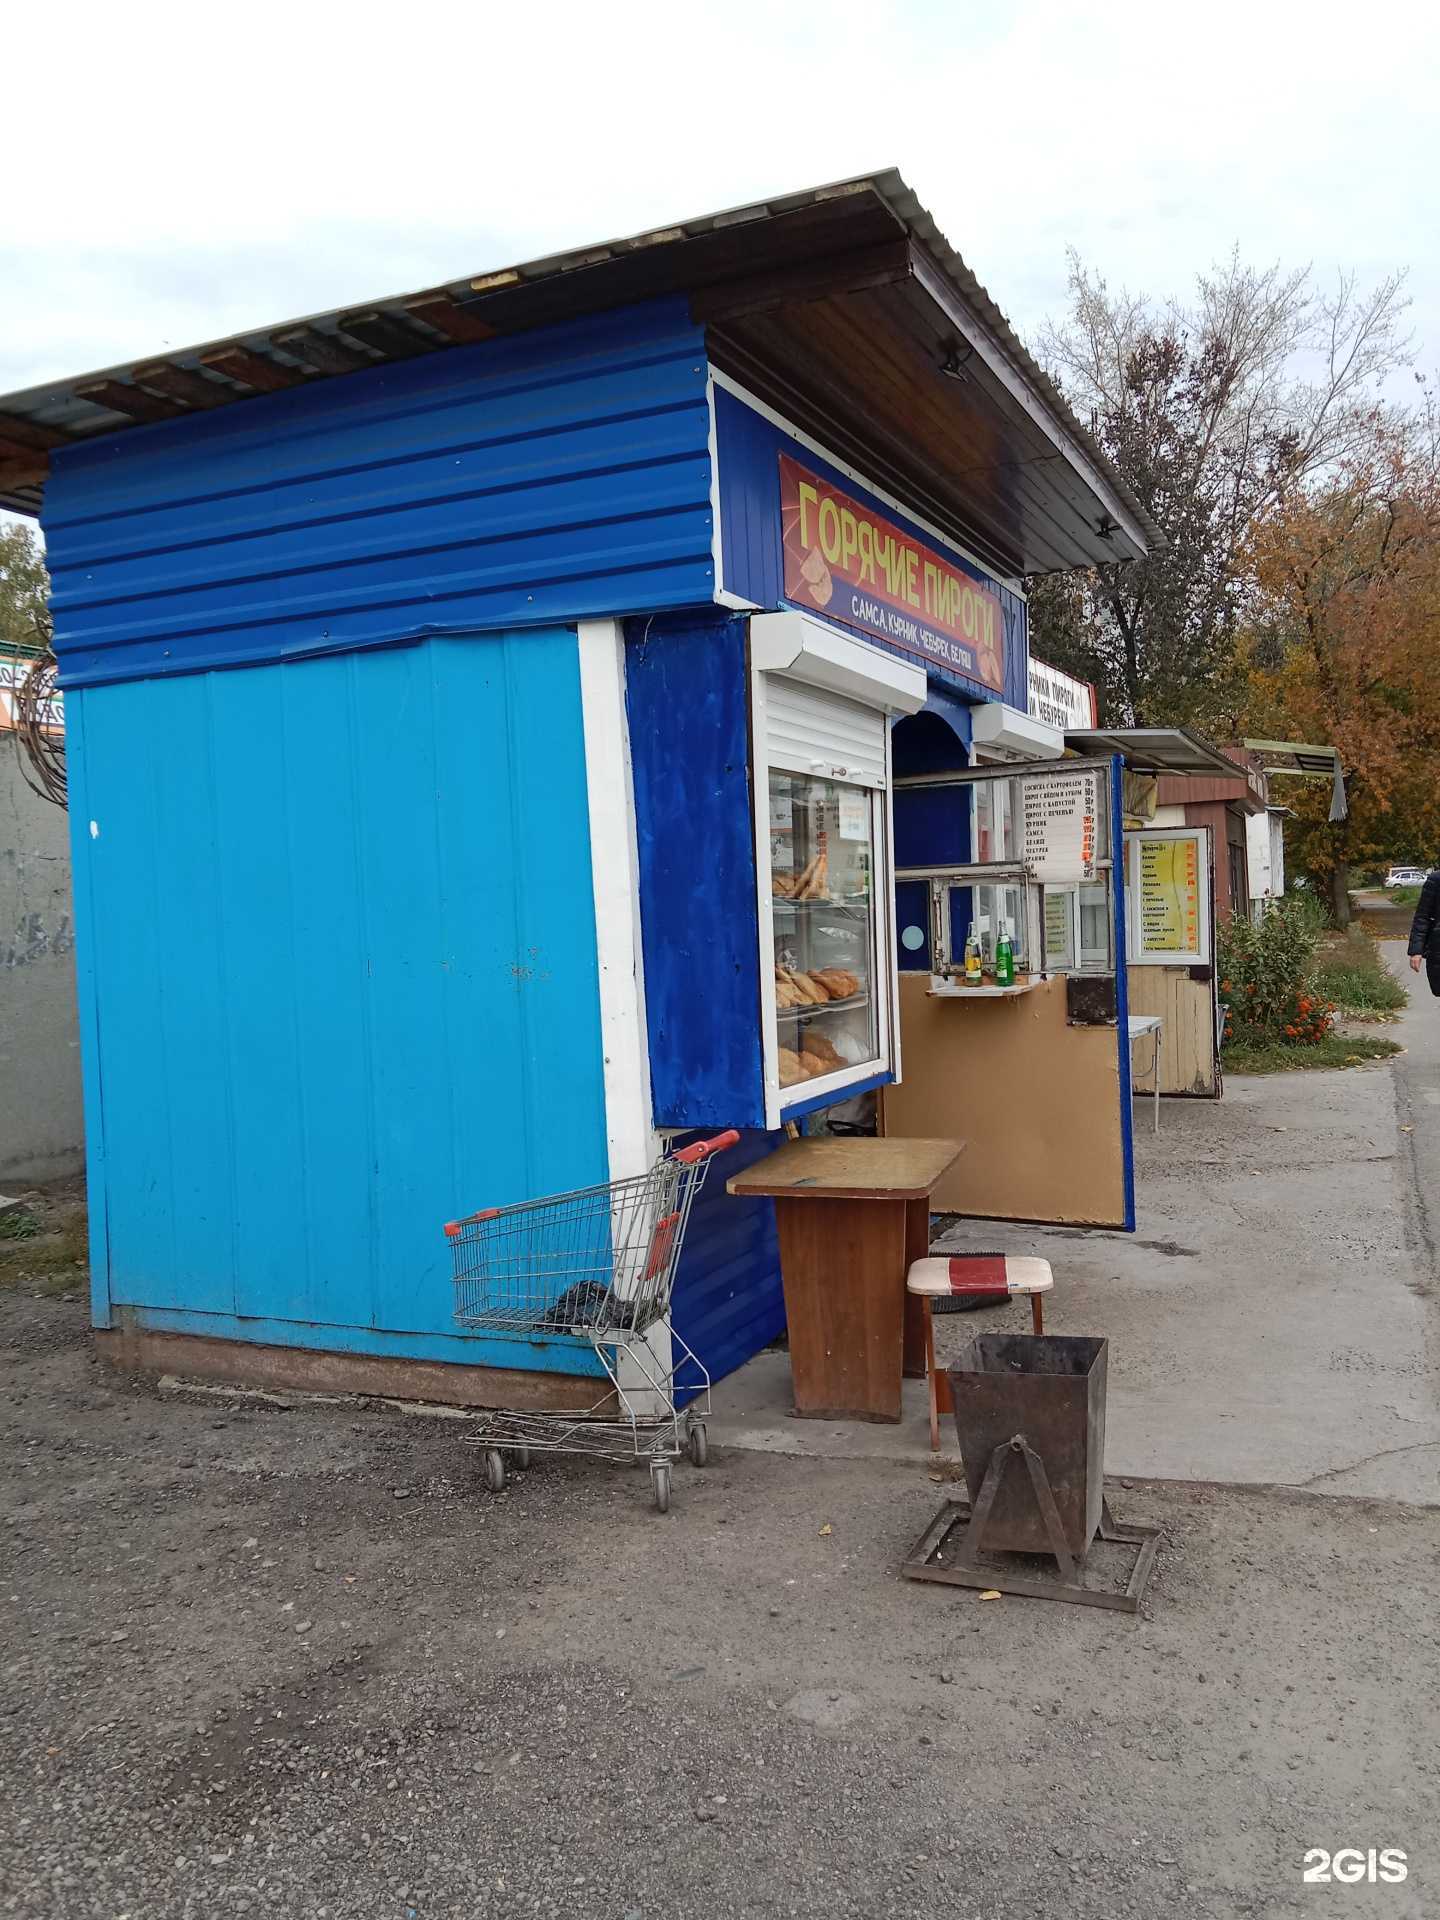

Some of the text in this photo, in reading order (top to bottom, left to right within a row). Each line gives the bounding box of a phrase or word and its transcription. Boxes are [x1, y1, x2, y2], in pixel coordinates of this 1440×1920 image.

[798, 481, 994, 649] ГОРЯЧИЕ ПИРОГИ
[851, 595, 972, 670] САМСА, КУРНИК, ЧЕБУРЕК, БЕЛЯШ
